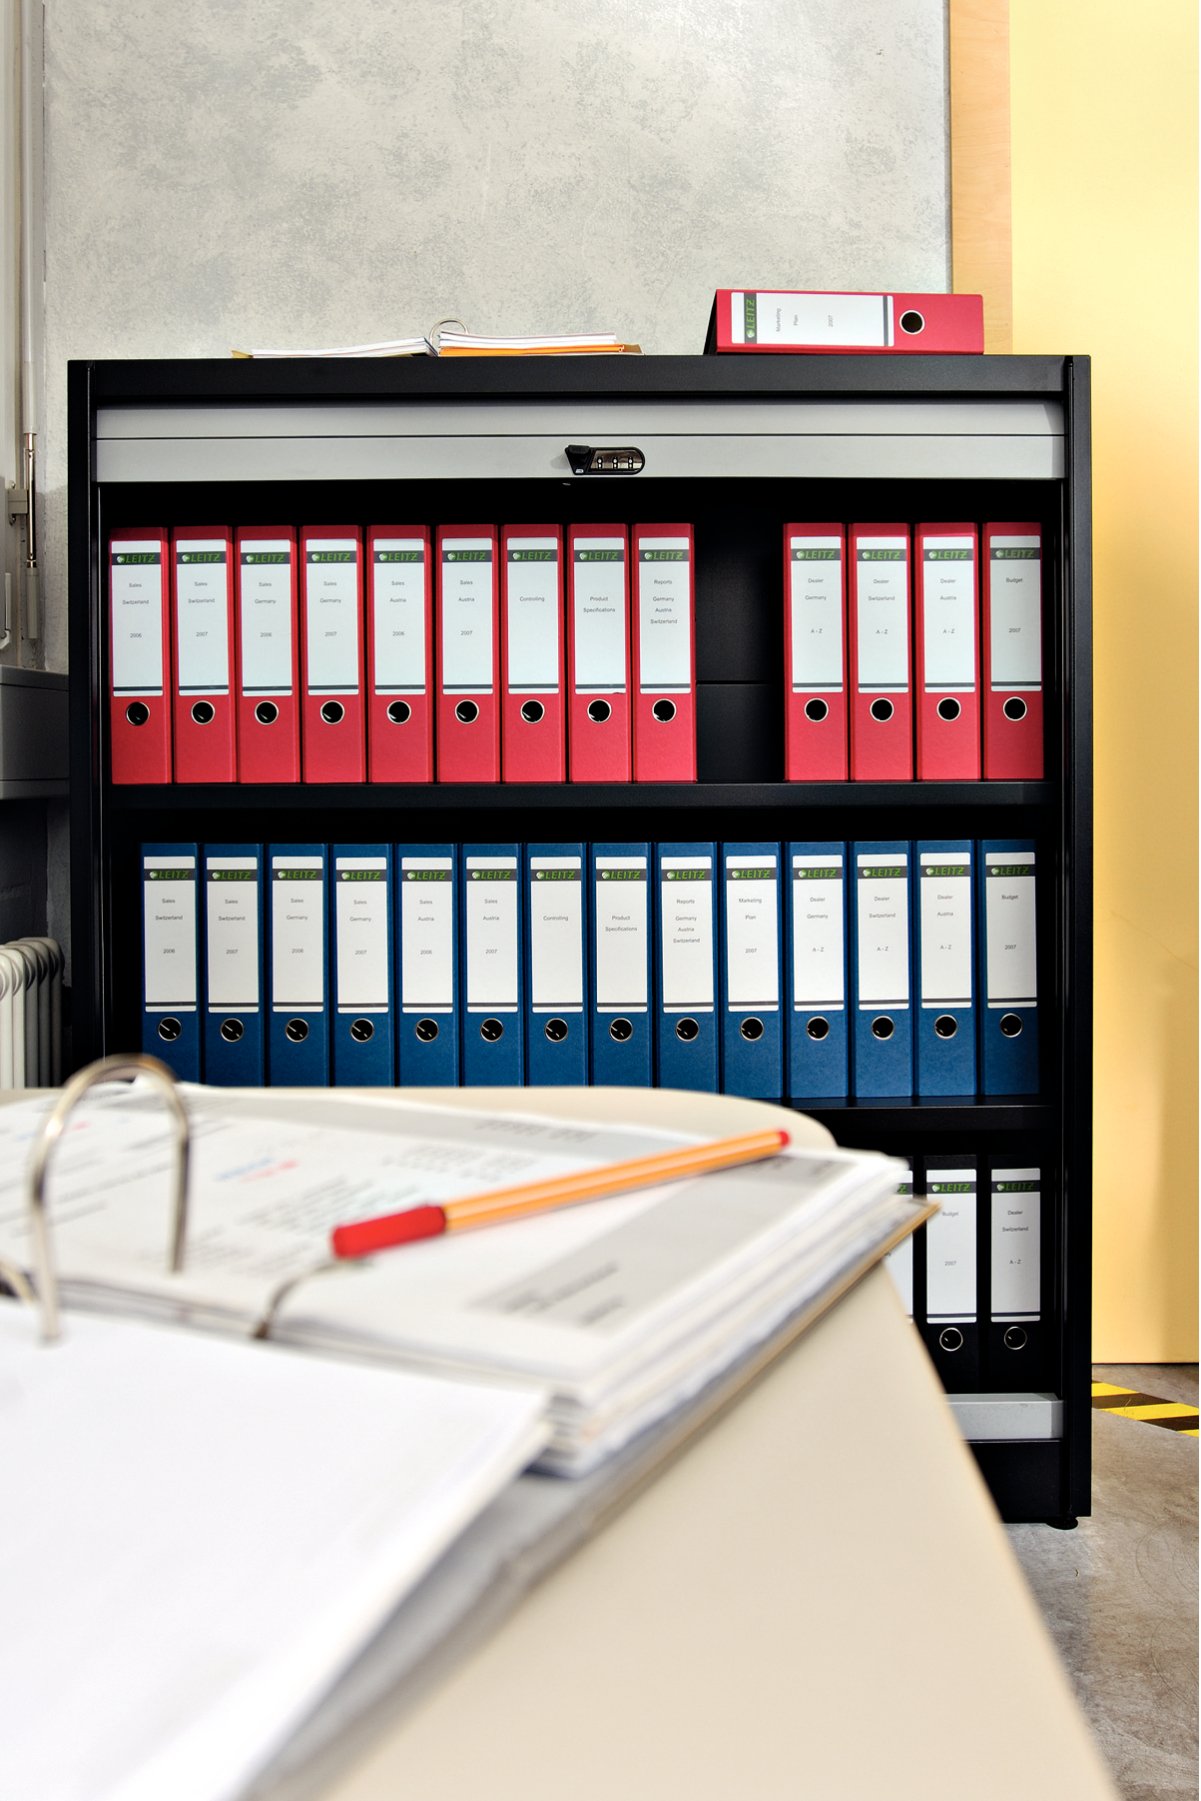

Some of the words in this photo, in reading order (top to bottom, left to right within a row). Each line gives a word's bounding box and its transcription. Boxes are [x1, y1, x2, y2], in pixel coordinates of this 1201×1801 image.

[746, 299, 755, 329] LEITZ
[191, 552, 221, 562] LEITZ
[321, 552, 350, 561] LEITZ
[389, 552, 417, 561] LEITZ
[456, 551, 485, 560] LEITZ
[522, 551, 551, 560] LEITZ
[589, 551, 618, 560] LEITZ
[654, 551, 683, 560] LEITZ
[806, 550, 834, 560] LEITZ
[871, 549, 900, 560] LEITZ
[938, 550, 967, 560] LEITZ
[1005, 549, 1033, 557] LEITZ
[126, 553, 154, 563] LEITZ
[256, 553, 285, 563] LEITZ
[159, 870, 188, 879] LEITZ
[222, 871, 251, 880] LEITZ
[287, 871, 317, 879] LEITZ
[417, 871, 445, 880] LEITZ
[481, 871, 510, 880] LEITZ
[546, 871, 574, 880] LEITZ
[611, 871, 640, 880] LEITZ
[676, 871, 704, 880] LEITZ
[740, 870, 769, 878] LEITZ
[806, 868, 836, 878] LEITZ
[872, 868, 900, 876] LEITZ
[935, 867, 964, 875] LEITZ
[1000, 867, 1029, 875] LEITZ
[351, 872, 380, 880] LEITZ
[941, 1184, 970, 1192] LEITZ
[1006, 1183, 1034, 1191] LEITZ
